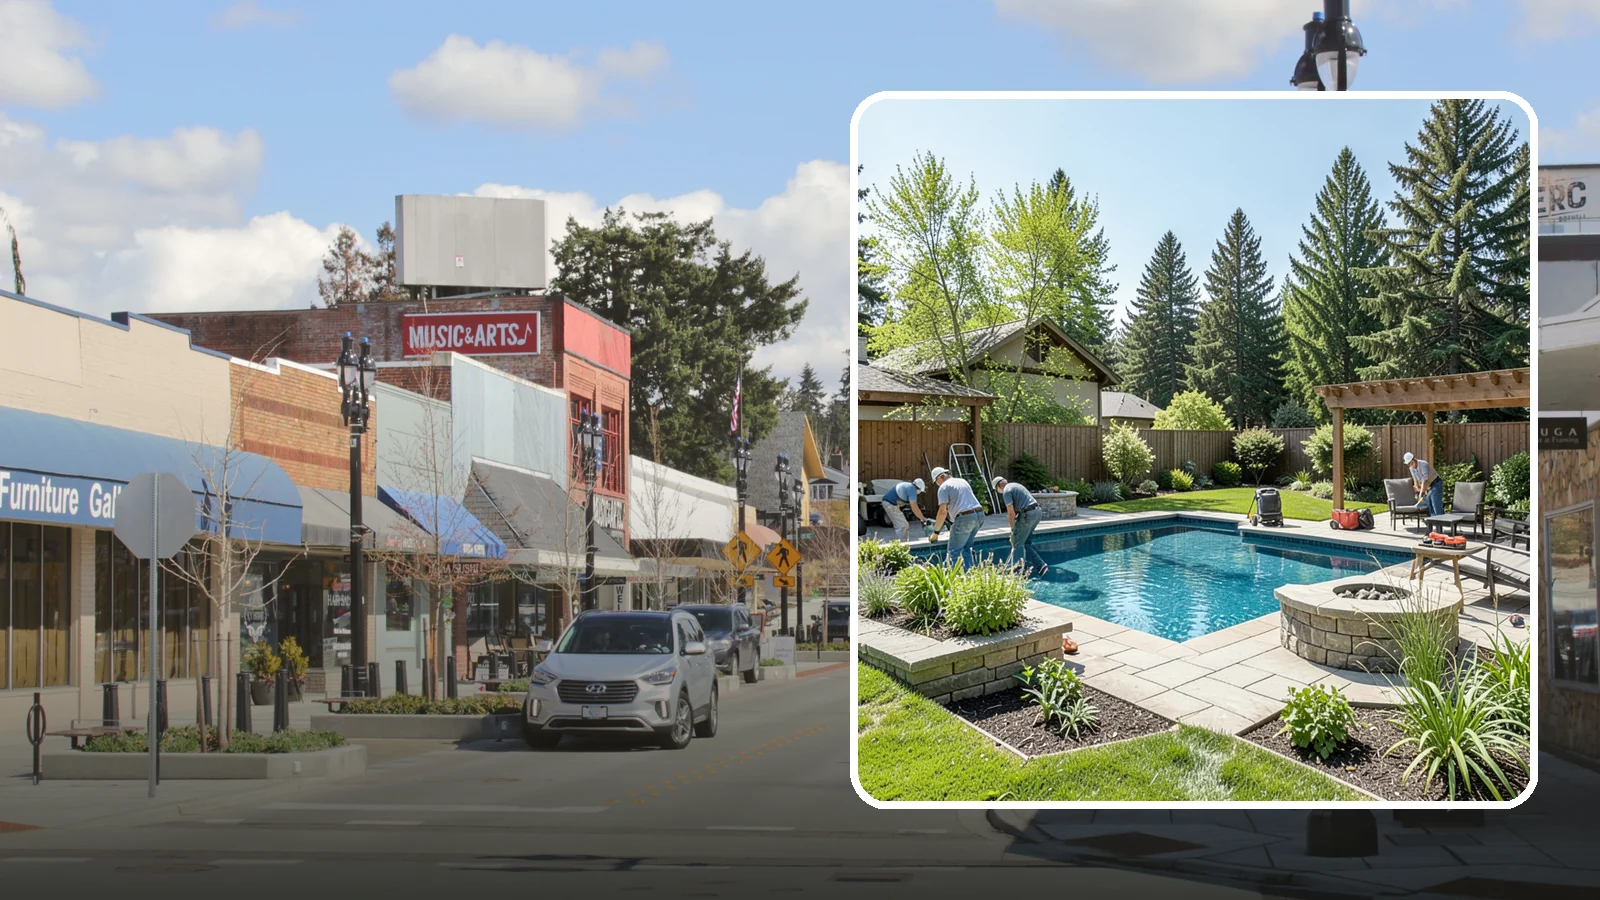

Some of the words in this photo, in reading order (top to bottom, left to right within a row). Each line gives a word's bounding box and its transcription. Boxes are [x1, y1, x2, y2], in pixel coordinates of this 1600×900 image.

[1540, 427, 1578, 437] UGA
[0, 471, 79, 515] Furniture
[89, 482, 122, 519] Gal
